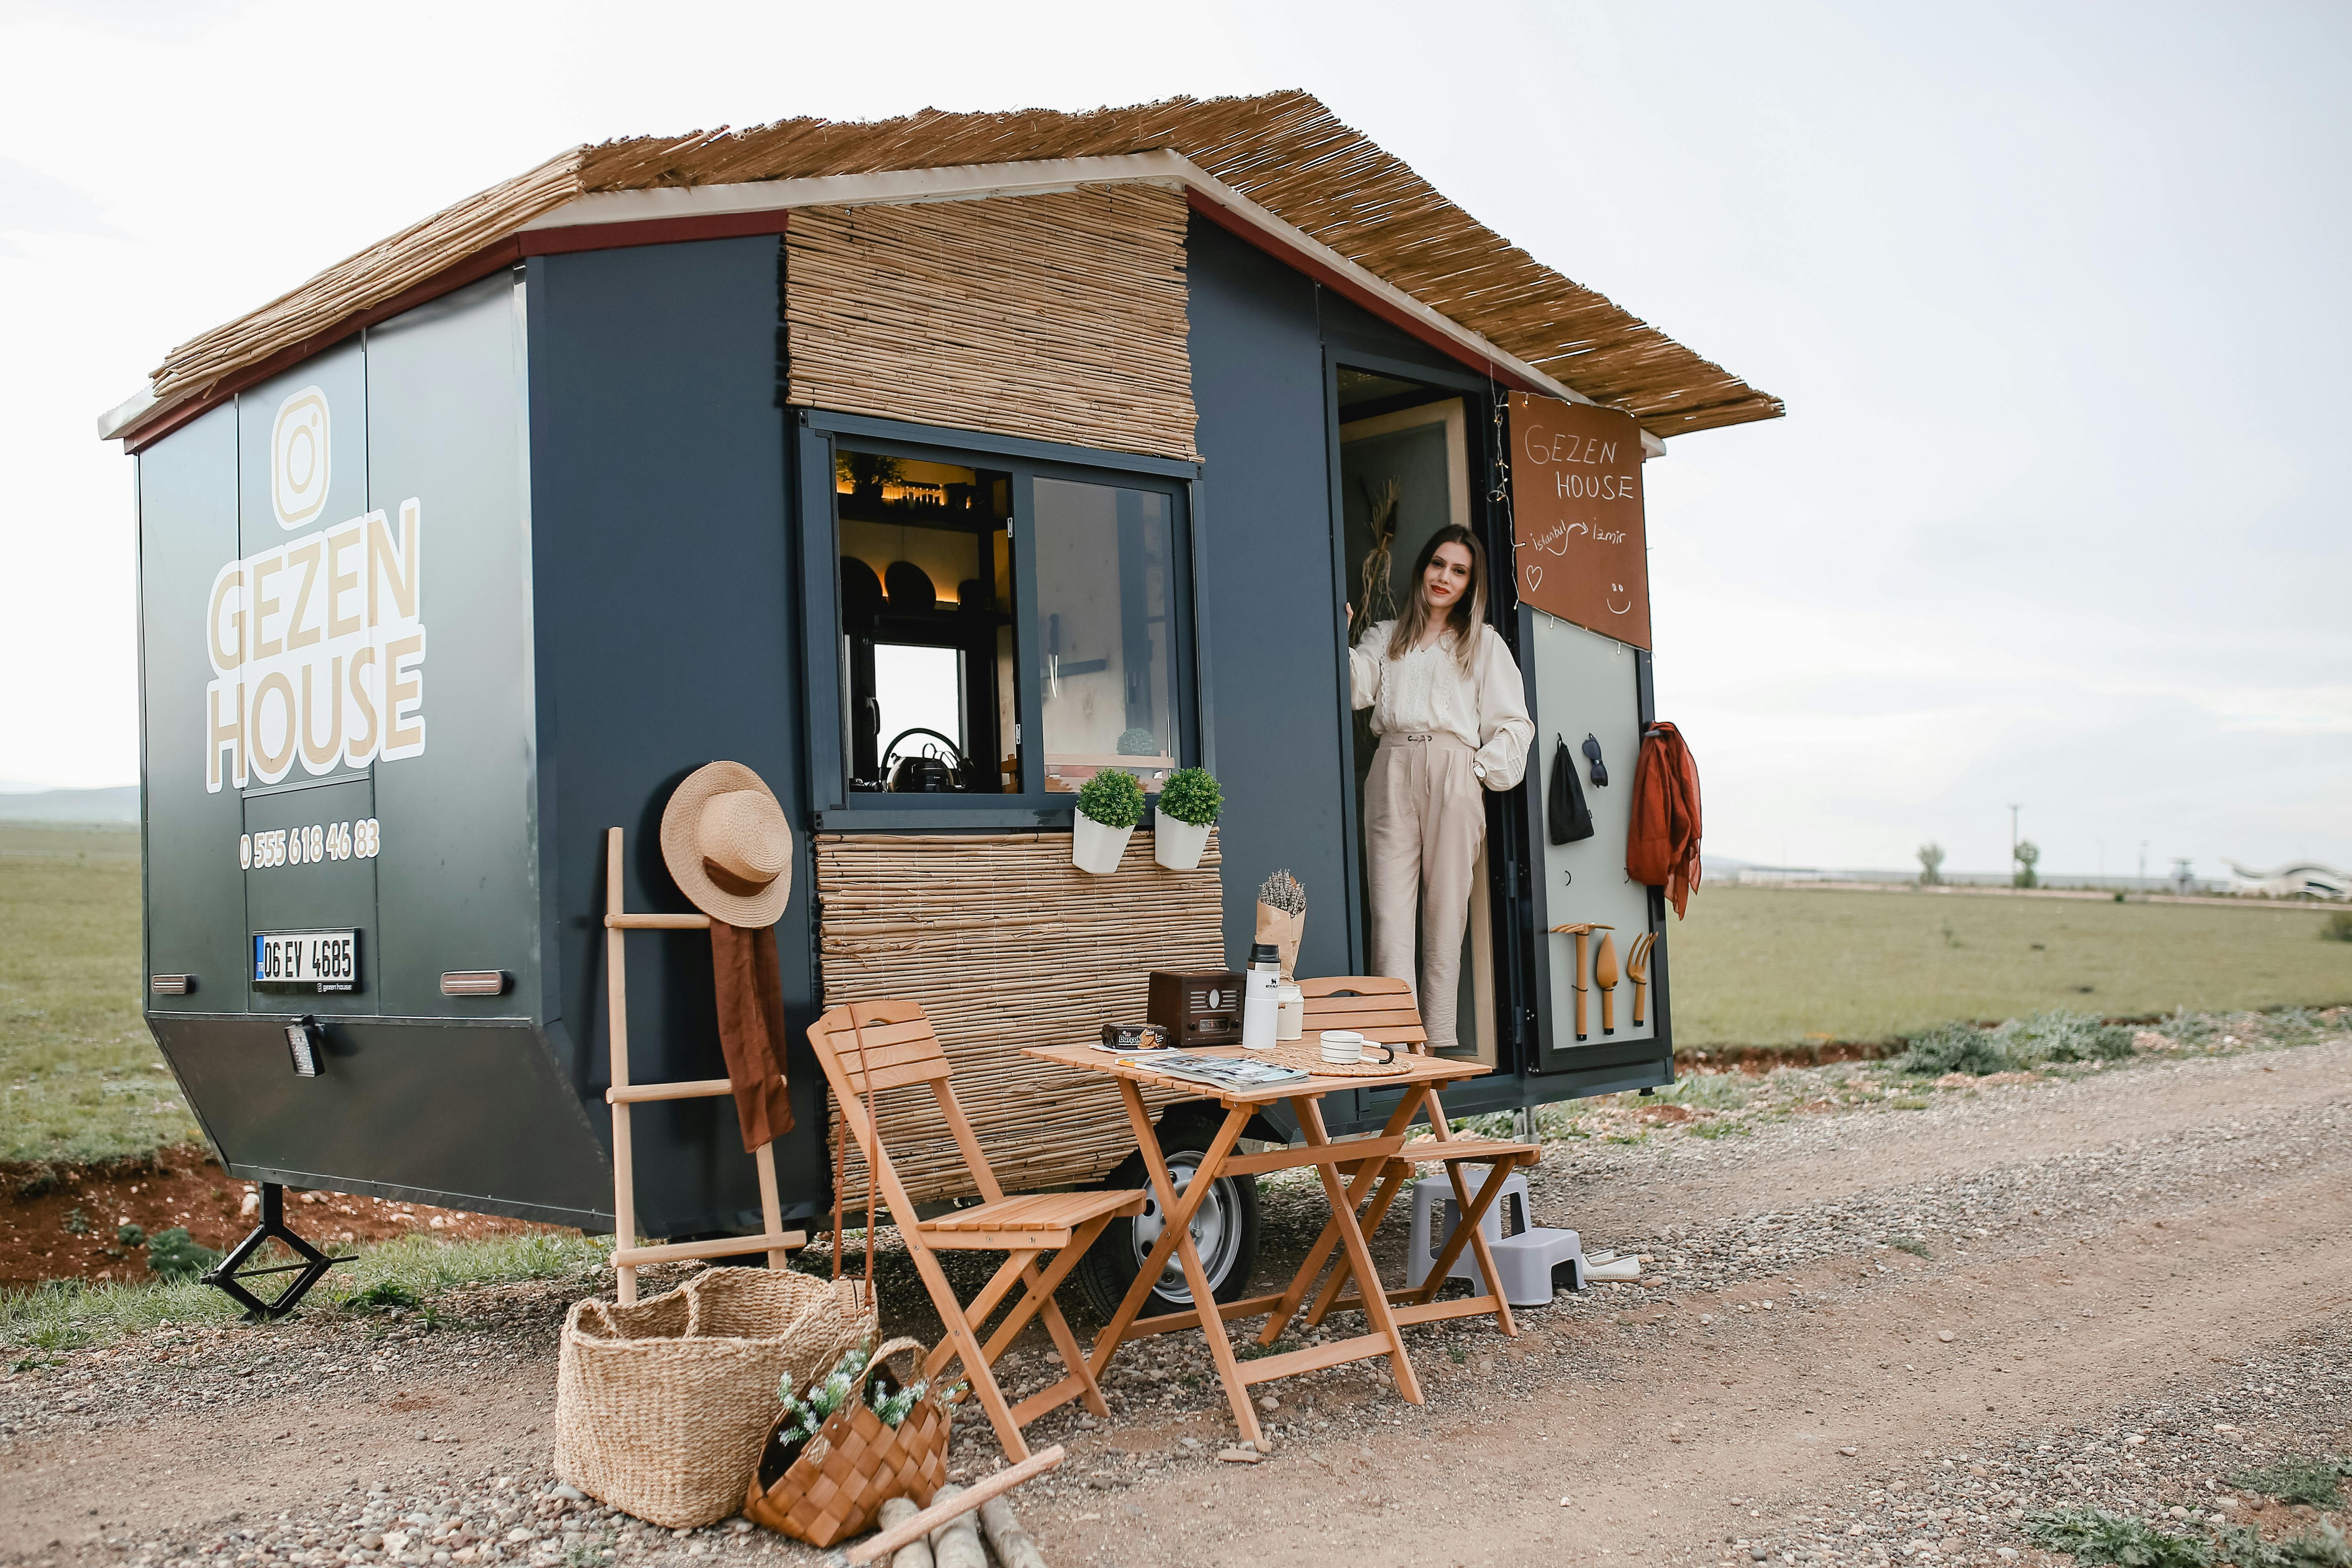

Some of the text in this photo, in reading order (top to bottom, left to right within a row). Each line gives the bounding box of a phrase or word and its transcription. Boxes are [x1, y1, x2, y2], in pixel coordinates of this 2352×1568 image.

[1525, 425, 1617, 464] GEZEN
[1556, 471, 1633, 500] HOUSE
[210, 506, 416, 672] GEZEN
[210, 633, 422, 785] HOUSE
[241, 820, 379, 869] 0 555 618 46 83
[258, 962, 264, 973] TR
[265, 940, 351, 978] 06 EV 4685
